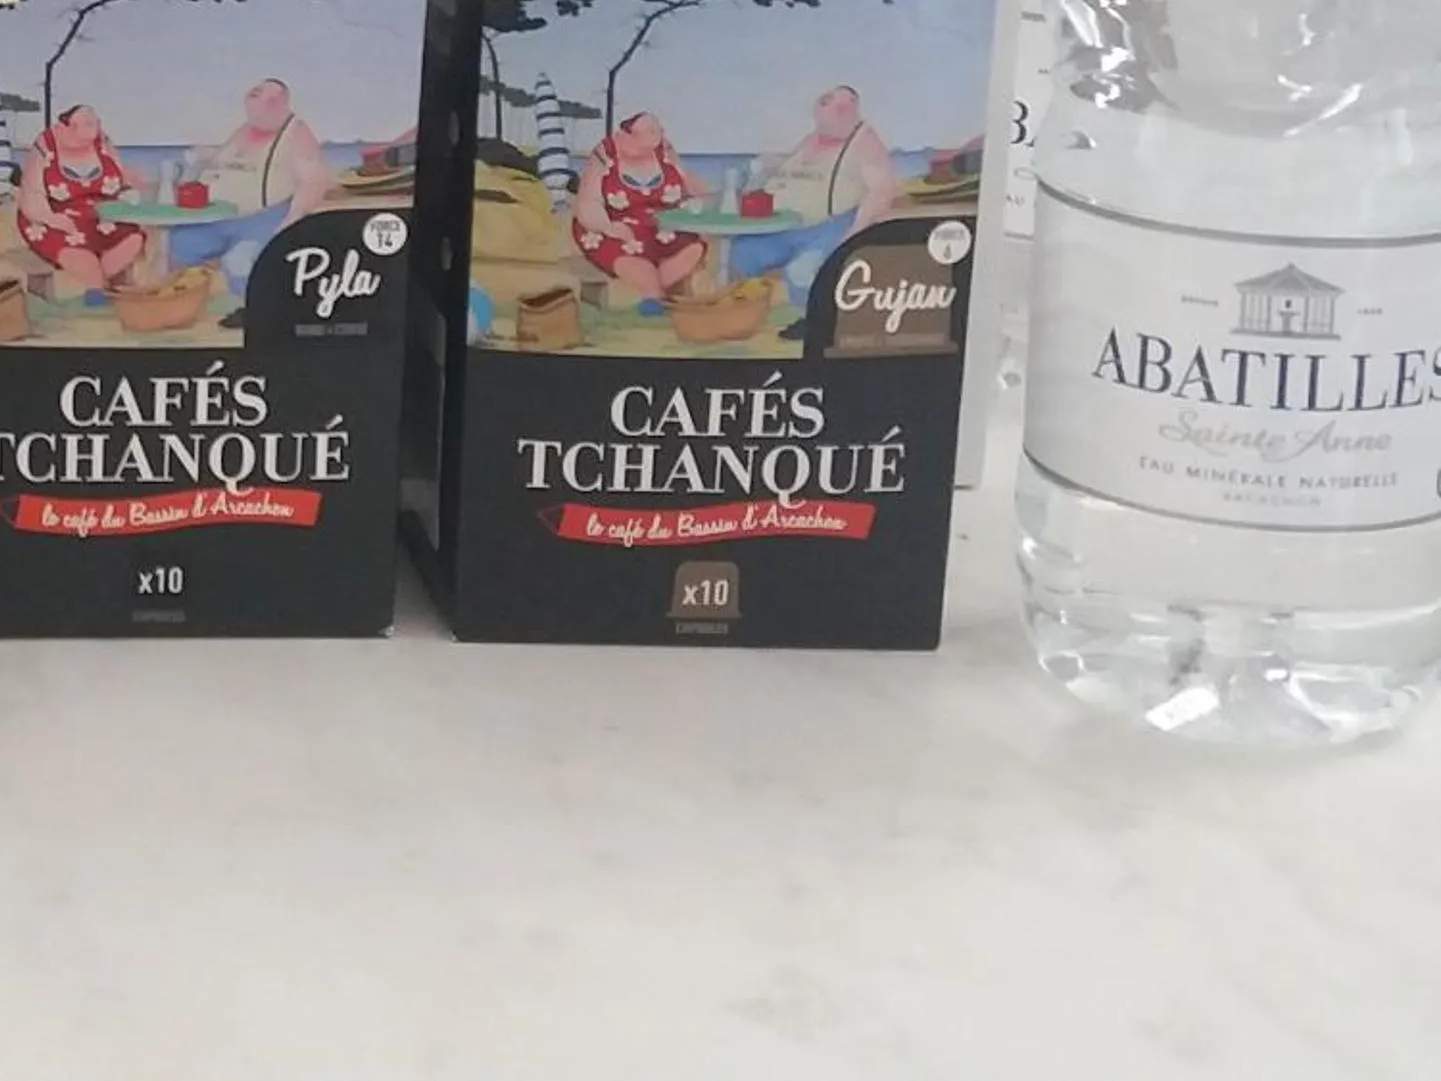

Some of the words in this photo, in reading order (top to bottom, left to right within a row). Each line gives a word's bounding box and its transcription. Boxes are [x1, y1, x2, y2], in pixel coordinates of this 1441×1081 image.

[286, 247, 381, 318] Pyla
[835, 260, 957, 333] Gujan
[60, 360, 268, 427] CAFÉS
[610, 371, 825, 438] CAFÉS
[517, 426, 906, 508] TCHANQUÉ
[137, 566, 184, 595] x10
[682, 579, 729, 606] x10
